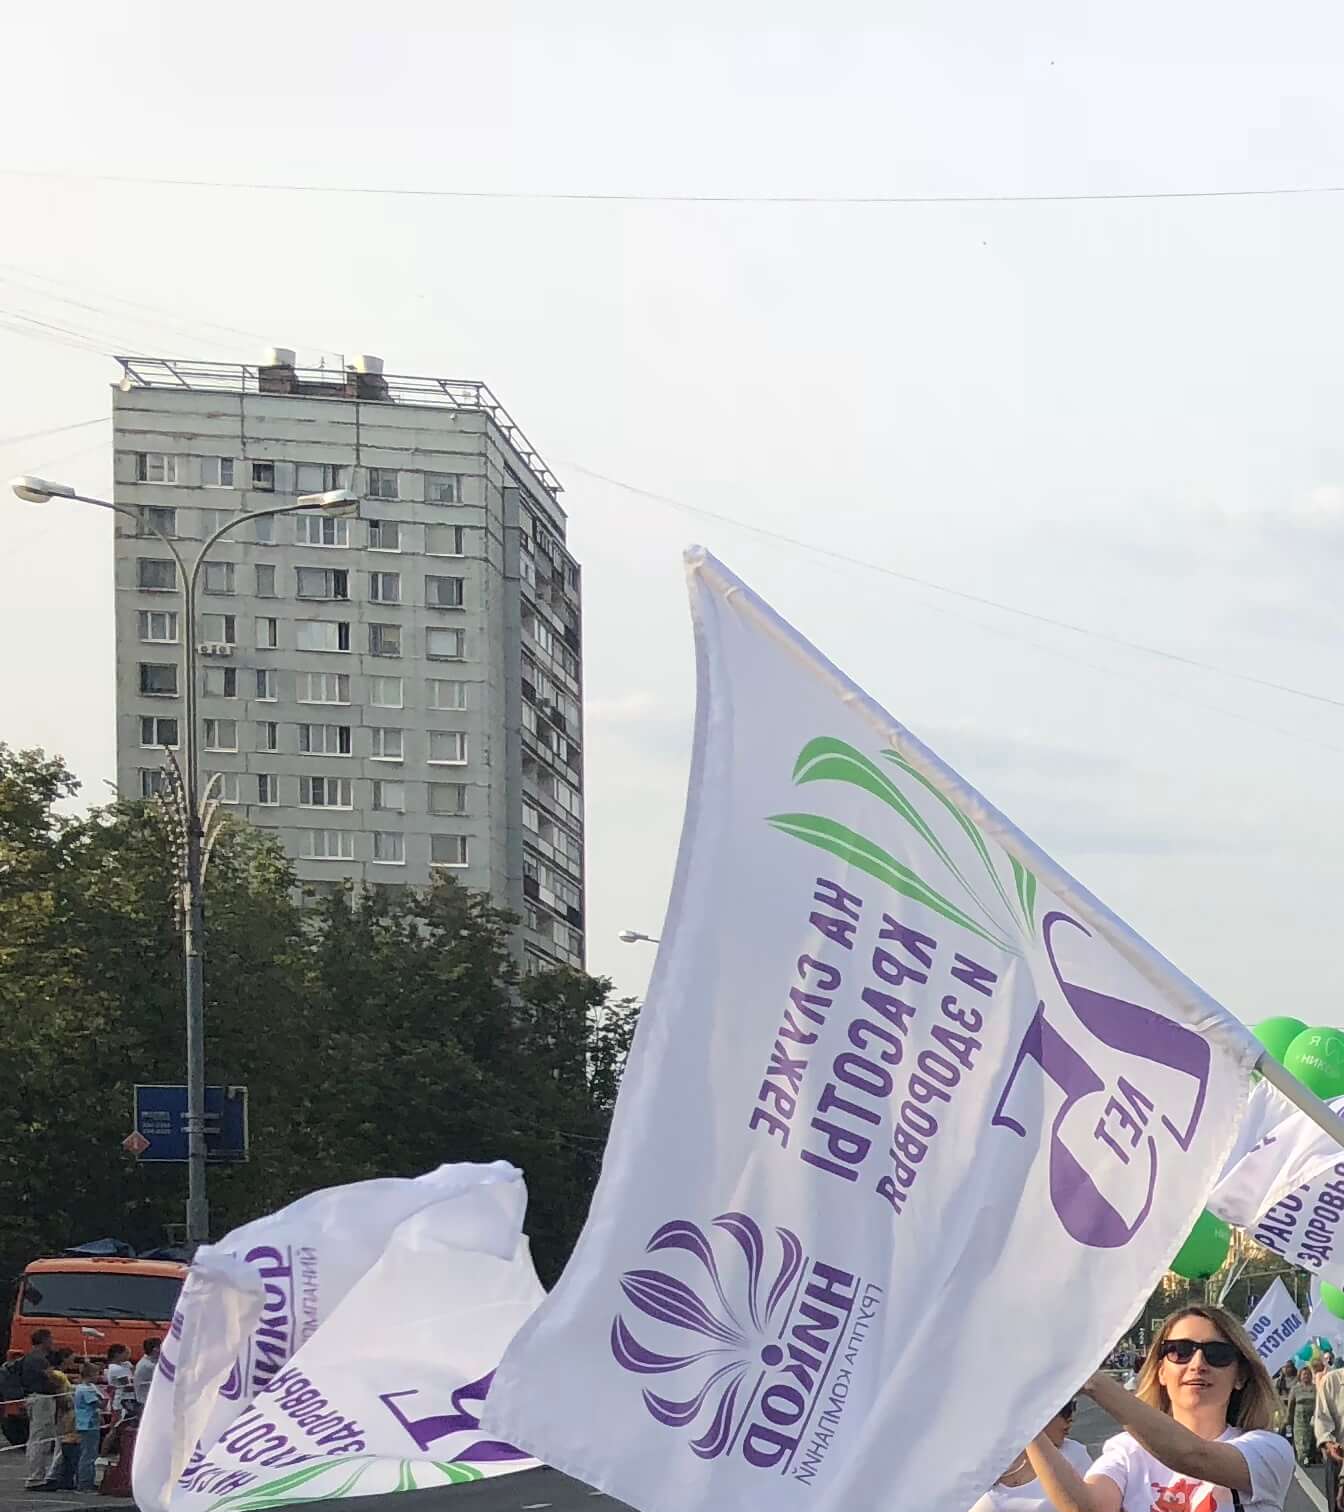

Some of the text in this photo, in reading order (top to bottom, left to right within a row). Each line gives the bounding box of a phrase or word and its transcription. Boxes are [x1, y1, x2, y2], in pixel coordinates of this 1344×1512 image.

[1309, 1035, 1321, 1048] Я
[297, 1246, 319, 1344] ОМПАНИЙ
[263, 1367, 366, 1456] ЗДОРОВЬЯ
